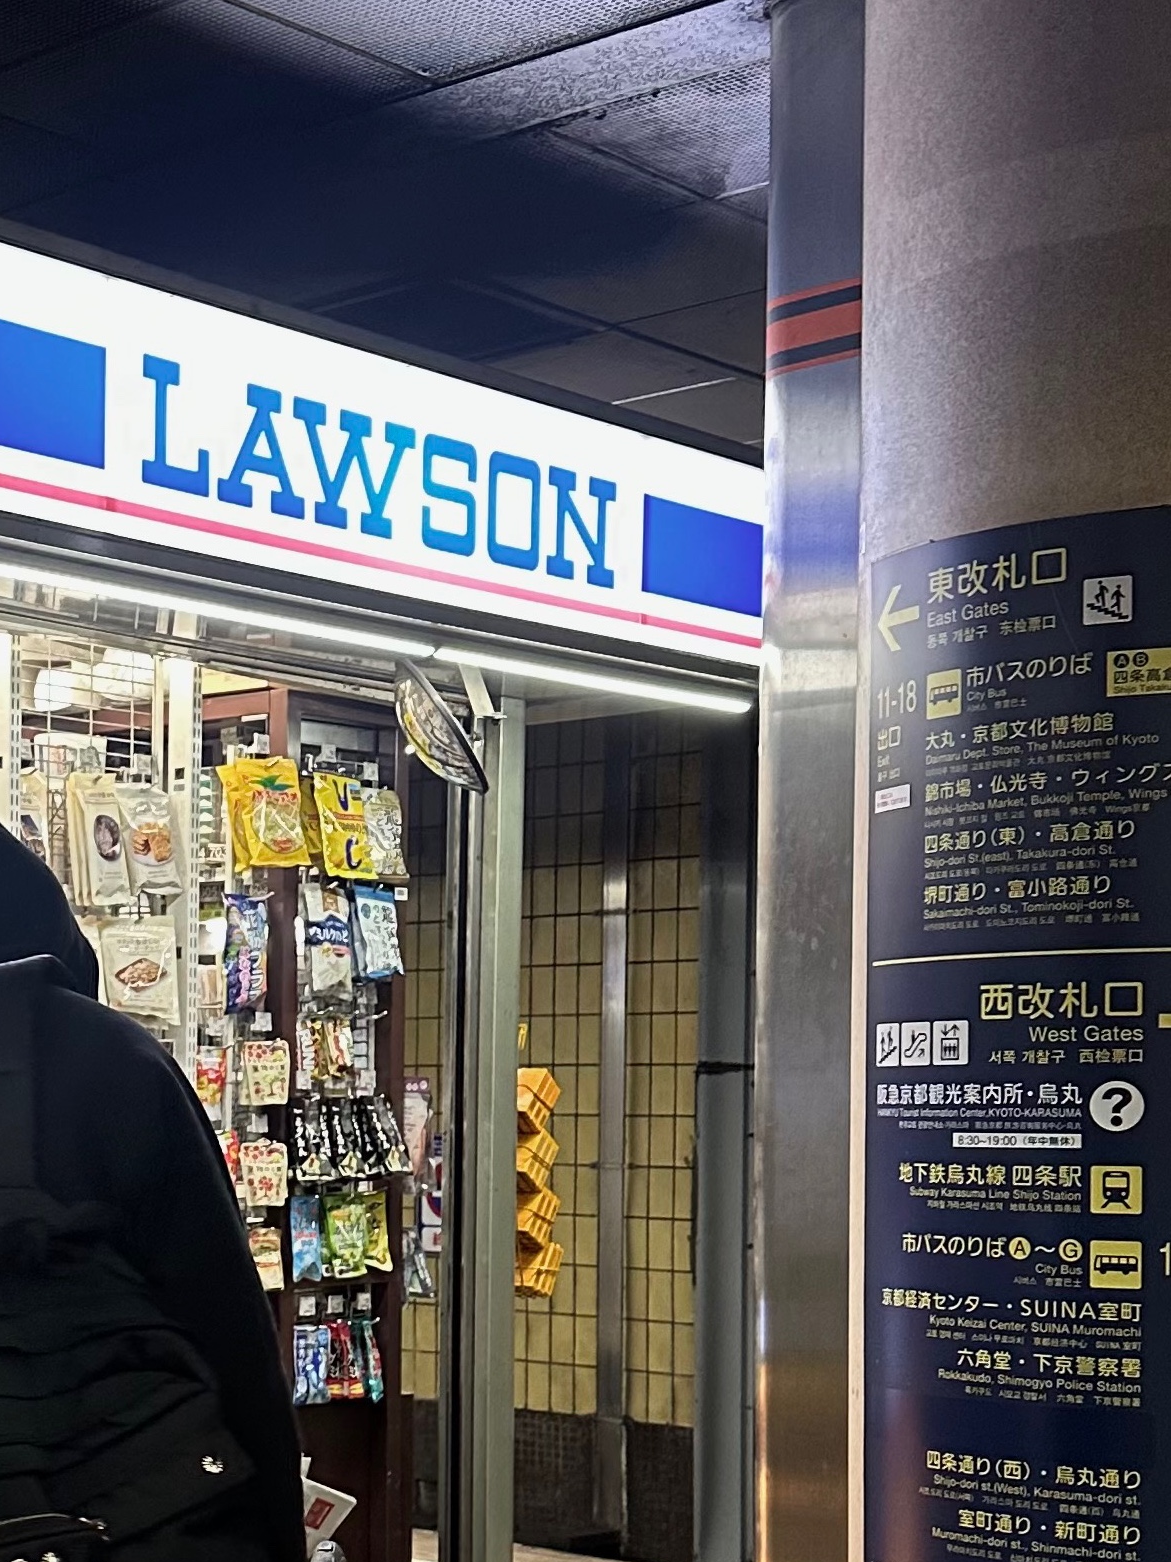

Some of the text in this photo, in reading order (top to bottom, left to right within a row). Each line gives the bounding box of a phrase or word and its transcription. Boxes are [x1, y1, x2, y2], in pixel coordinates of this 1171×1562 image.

[140, 352, 616, 589] LAWSON
[927, 547, 1067, 605] 東改札口
[927, 601, 1009, 628] East Gates
[965, 653, 1093, 687] 市バスのりば
[877, 679, 917, 719] 11-18
[966, 688, 1007, 703] City Bus
[877, 725, 902, 751] 出口
[1027, 741, 1048, 752] The
[1051, 738, 1102, 750] Museum
[1106, 735, 1118, 746] of
[1122, 734, 1159, 747] Kyoto
[1030, 792, 1074, 805] Bukkoji
[1128, 788, 1168, 800] Wings
[924, 855, 966, 869] Shijo-dori
[1017, 846, 1095, 860] Takakura-dori
[1099, 844, 1116, 855] St.
[1021, 899, 1112, 913] Tominokoji-dori
[1116, 898, 1134, 909] St.
[980, 981, 1143, 1020] 西改札口
[1029, 1025, 1144, 1042] West Gates
[898, 1162, 1082, 1188] 地下鉄烏丸線 四条駅
[909, 1185, 1081, 1202] Subway Karasuma Line Shijo Station
[1035, 1263, 1083, 1276] City Bus
[929, 1314, 955, 1328] Kyoto
[957, 1316, 987, 1329] Keizai
[1030, 1321, 1070, 1334] SUINA
[1072, 1324, 1142, 1337] Muromachi
[997, 1373, 1053, 1389] Shimogyo
[1056, 1378, 1093, 1391] Police
[1096, 1380, 1142, 1394] Station
[933, 1473, 978, 1489] Shijo-dori
[1033, 1486, 1122, 1504] Karasuma-dori
[1125, 1495, 1141, 1506] st.
[931, 1526, 1008, 1548] Muromachi-dori
[1031, 1540, 1122, 1559] Shinmachi-dori
[1124, 1551, 1141, 1562] st.
